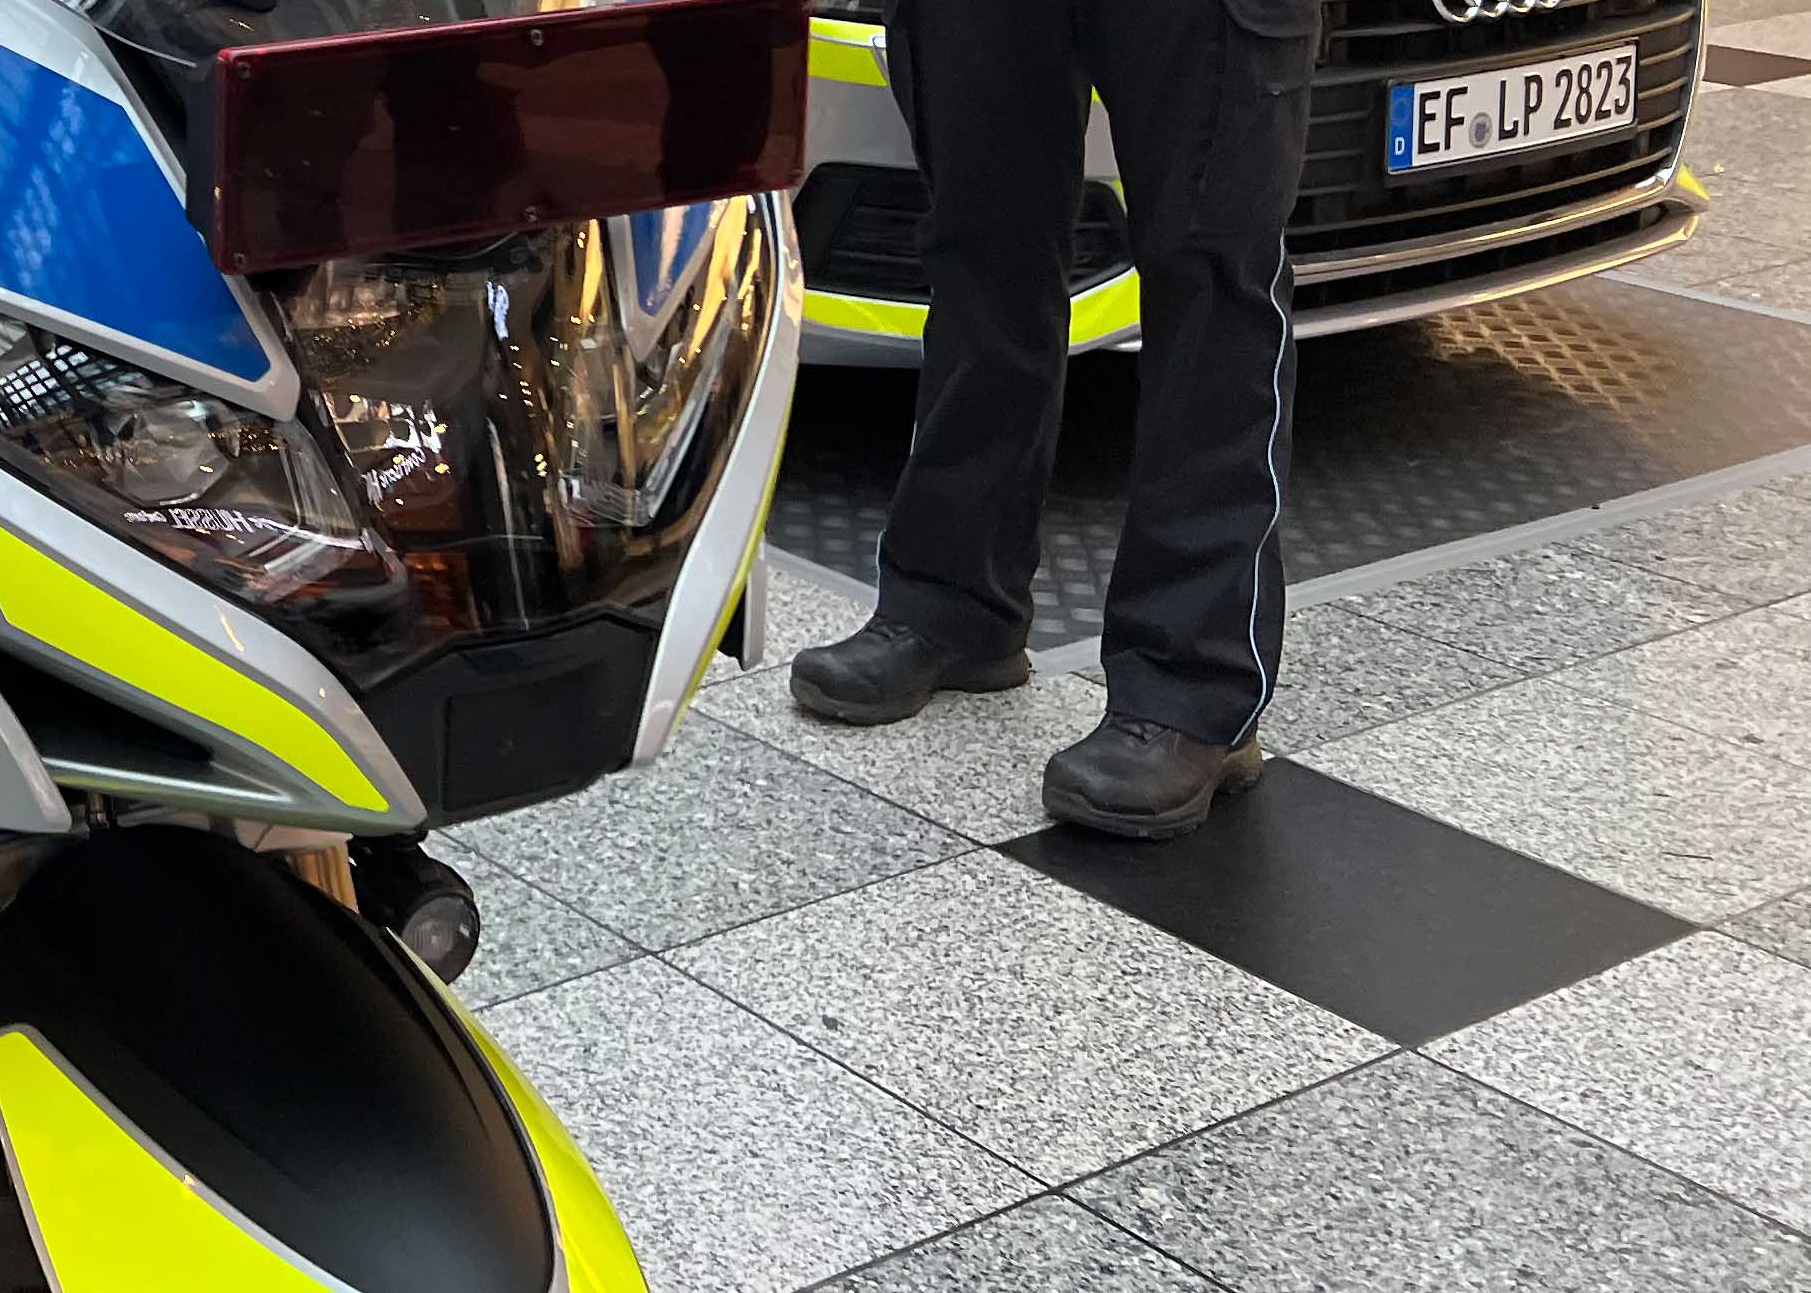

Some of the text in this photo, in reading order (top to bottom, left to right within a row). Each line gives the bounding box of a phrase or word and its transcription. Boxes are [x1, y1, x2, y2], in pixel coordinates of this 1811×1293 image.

[1417, 55, 1632, 155] EF LP 2823
[1394, 136, 1405, 155] D
